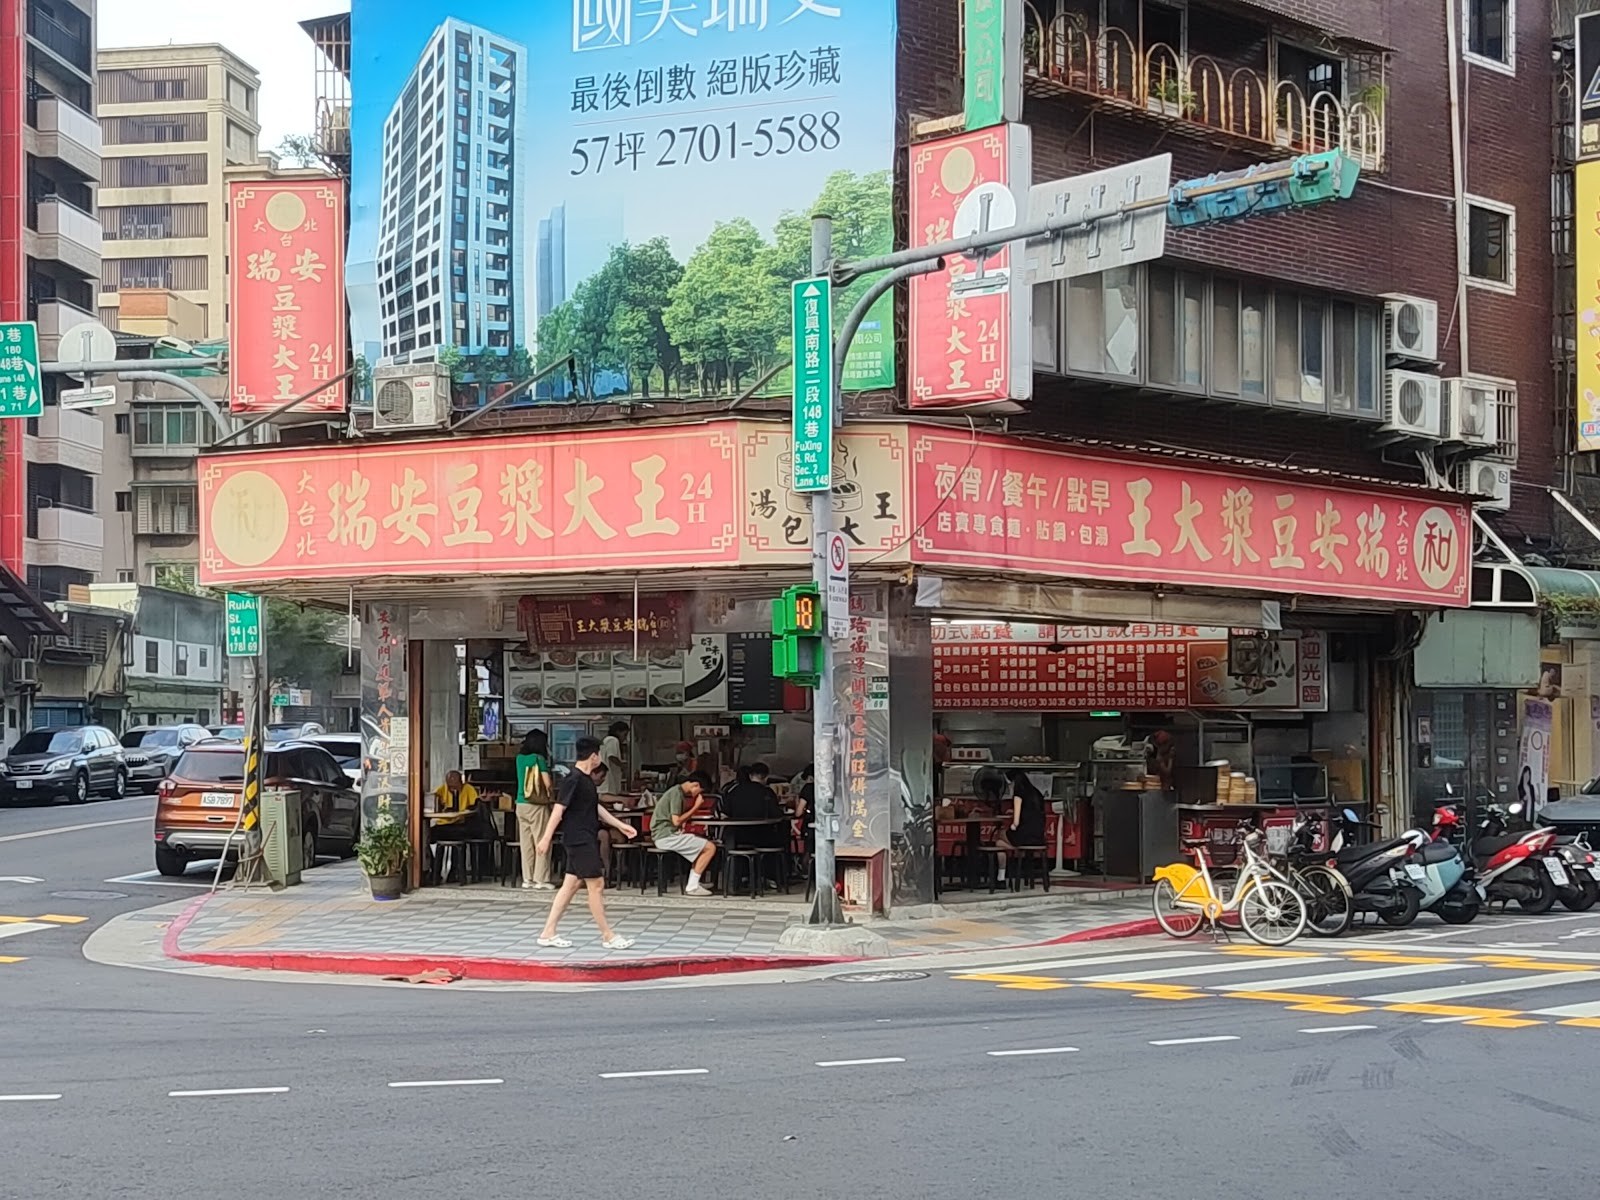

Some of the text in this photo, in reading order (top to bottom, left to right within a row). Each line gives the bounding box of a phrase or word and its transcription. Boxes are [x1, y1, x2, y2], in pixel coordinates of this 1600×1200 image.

[570, 45, 842, 113] 最後倒數 絕版珍藏
[570, 111, 842, 176] 57坪 2701-5588
[977, 318, 999, 343] 24
[309, 343, 333, 364] 24
[980, 343, 997, 363] H
[312, 364, 330, 381] H
[795, 441, 822, 452] FuXing
[795, 453, 817, 463] S. Rd.
[795, 464, 818, 475] Sec. 2
[795, 474, 829, 486] Lane 148
[680, 472, 713, 502] 24
[327, 453, 681, 552] 瑞安豆漿大王
[688, 502, 706, 524] H
[296, 470, 318, 559] 大台北
[1395, 504, 1409, 583] 大台北
[231, 626, 241, 636] 94
[230, 642, 243, 652] 178
